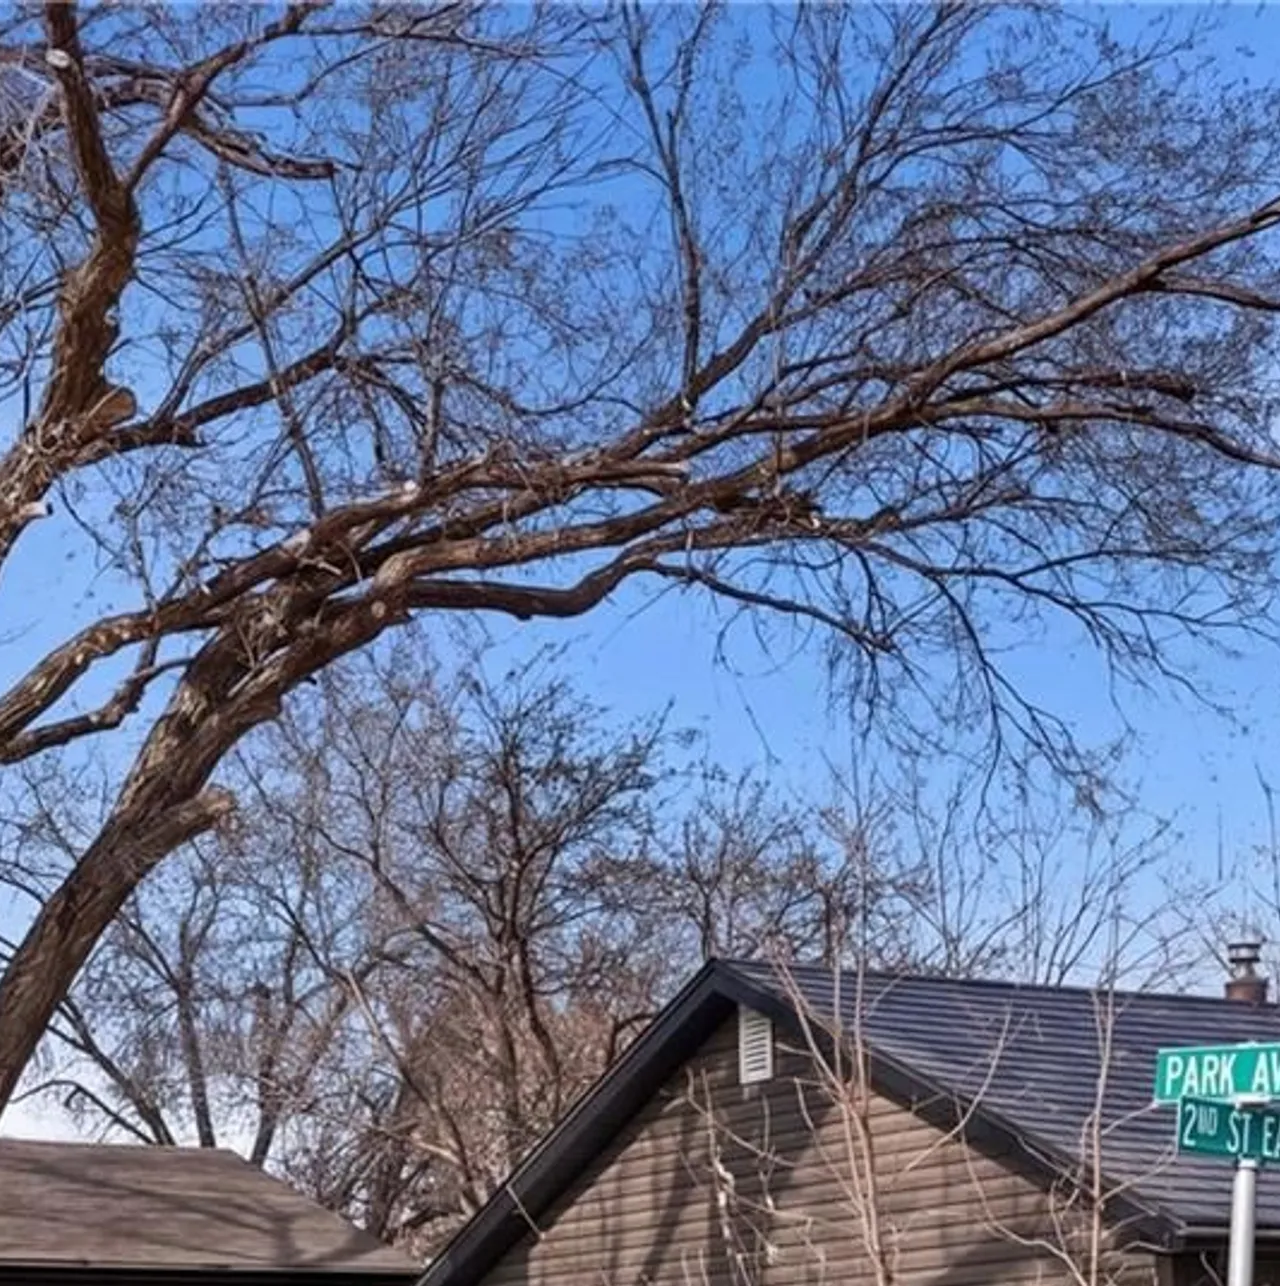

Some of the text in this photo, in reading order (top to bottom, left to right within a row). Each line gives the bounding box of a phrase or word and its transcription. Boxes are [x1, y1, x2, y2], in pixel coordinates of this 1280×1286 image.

[1165, 1053, 1237, 1096] PARK
[1182, 1104, 1218, 1147] 2ND
[1226, 1110, 1253, 1155] ST
